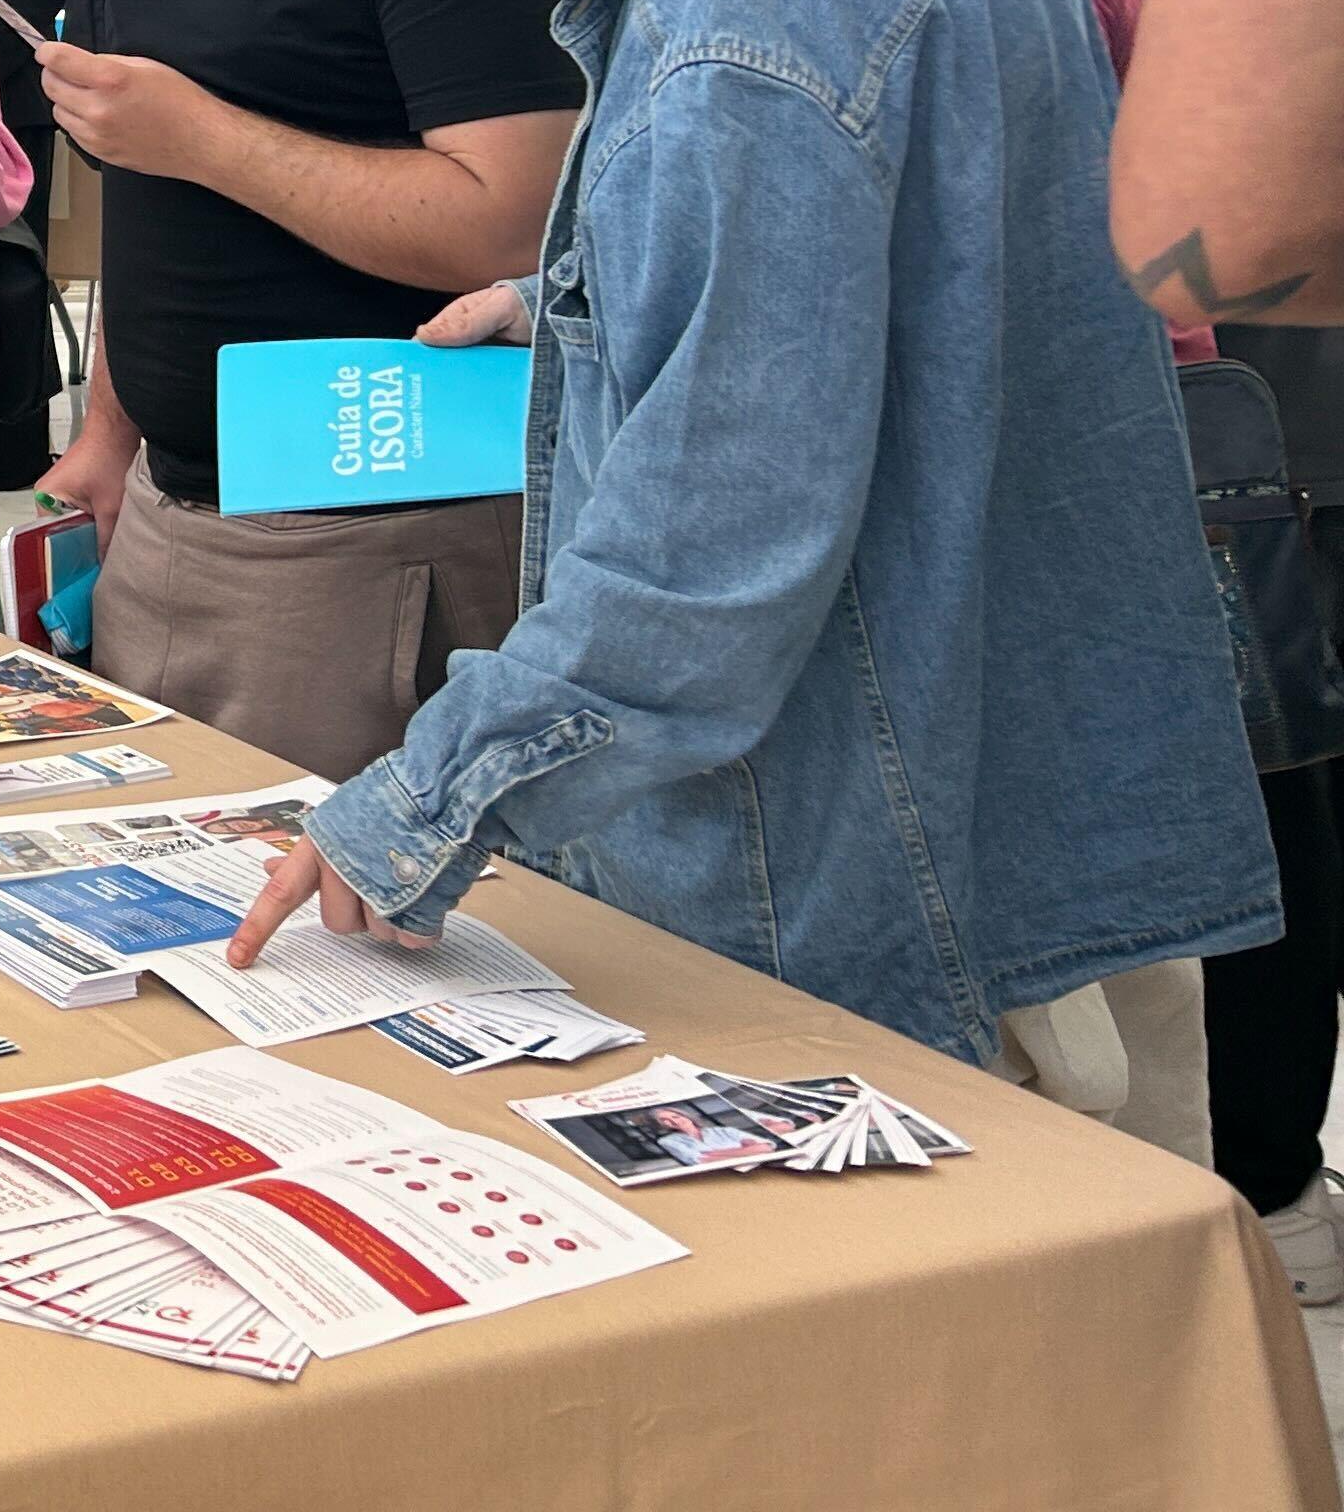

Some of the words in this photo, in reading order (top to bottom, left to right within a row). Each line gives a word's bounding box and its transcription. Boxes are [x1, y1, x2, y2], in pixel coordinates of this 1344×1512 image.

[328, 365, 361, 399] de
[327, 404, 363, 476] Guía
[368, 365, 407, 473] ISORA
